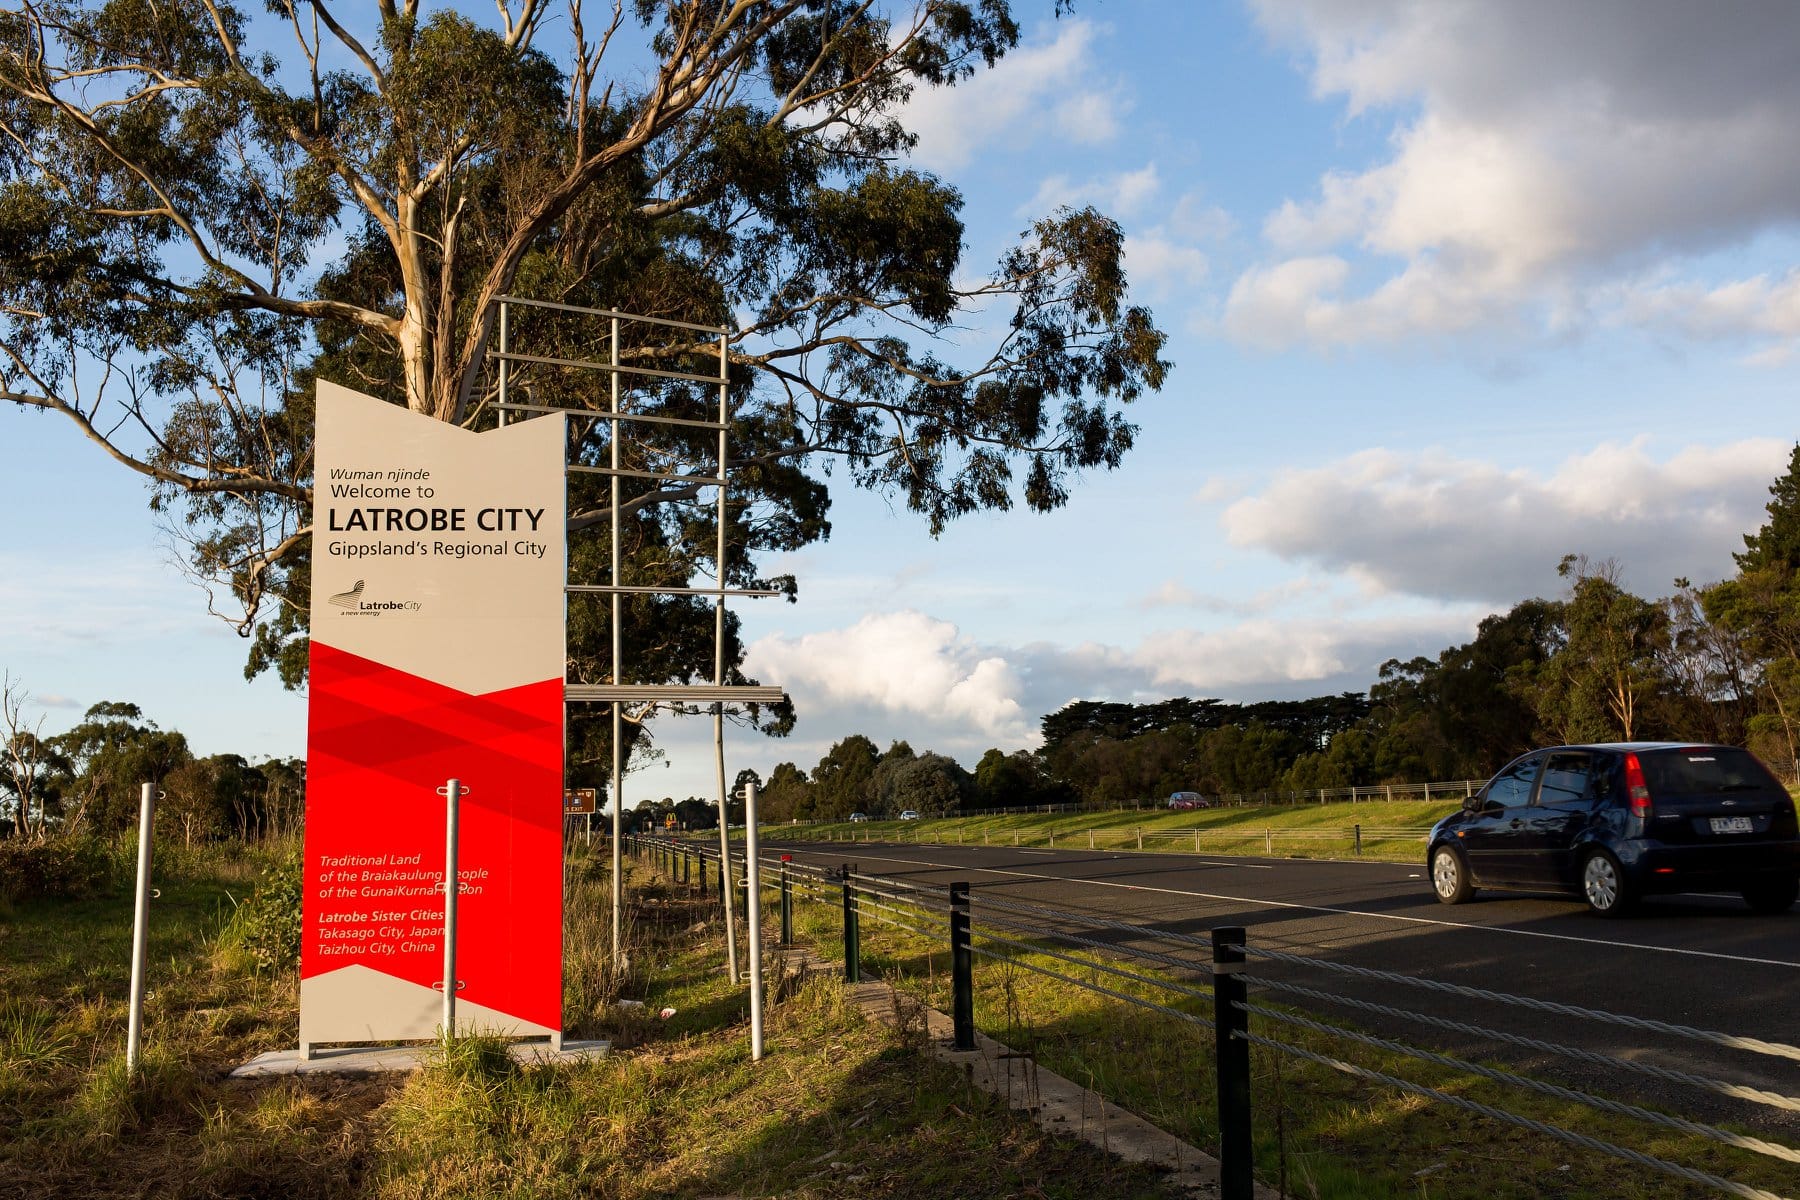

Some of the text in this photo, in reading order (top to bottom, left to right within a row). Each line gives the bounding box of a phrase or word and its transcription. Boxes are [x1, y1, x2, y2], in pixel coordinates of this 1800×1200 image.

[331, 469, 429, 482] Wuman njinde
[331, 484, 434, 498] Welcome to
[329, 508, 545, 531] LATROBE CITY
[434, 541, 507, 559] Regional
[515, 541, 546, 558] City
[321, 854, 421, 866] Traditional Land
[320, 867, 489, 882] of the Braiakaulung eople
[320, 887, 334, 898] of
[337, 887, 357, 897] the
[319, 909, 444, 923] Latrobe Sister Cities
[319, 926, 444, 940] Takasago City, Japan
[318, 942, 435, 956] Taizhou City, China
